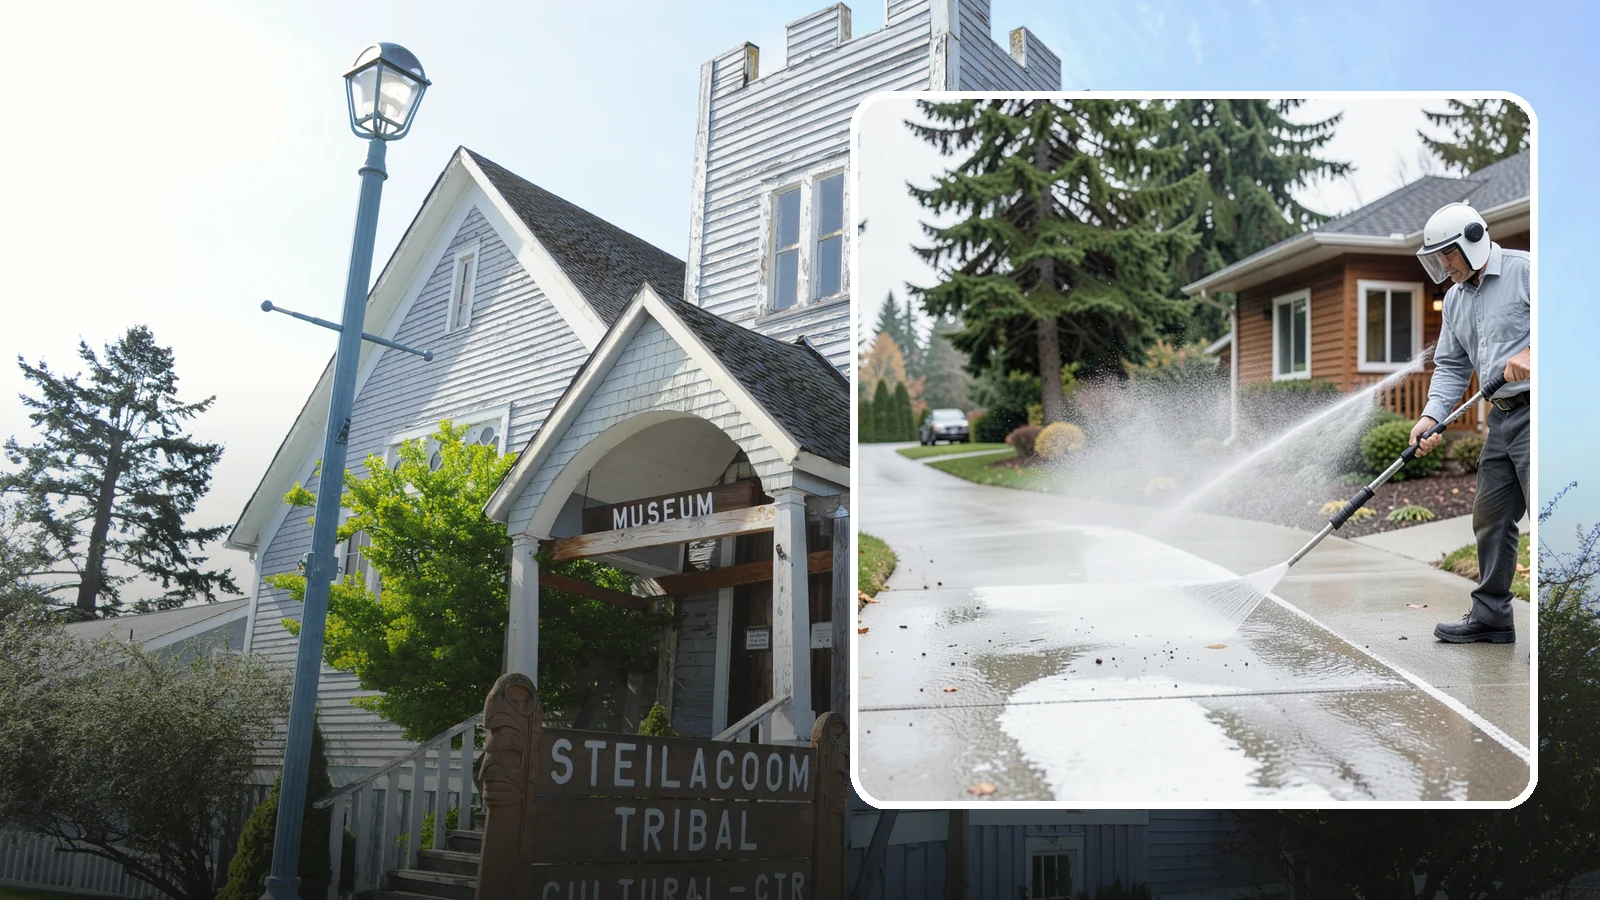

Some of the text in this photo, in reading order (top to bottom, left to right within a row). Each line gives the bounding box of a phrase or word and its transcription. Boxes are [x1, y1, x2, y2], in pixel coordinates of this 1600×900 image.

[614, 491, 713, 530] MUSEUM
[551, 739, 809, 791] STEILACOOM
[615, 807, 757, 851] TRIBAL
